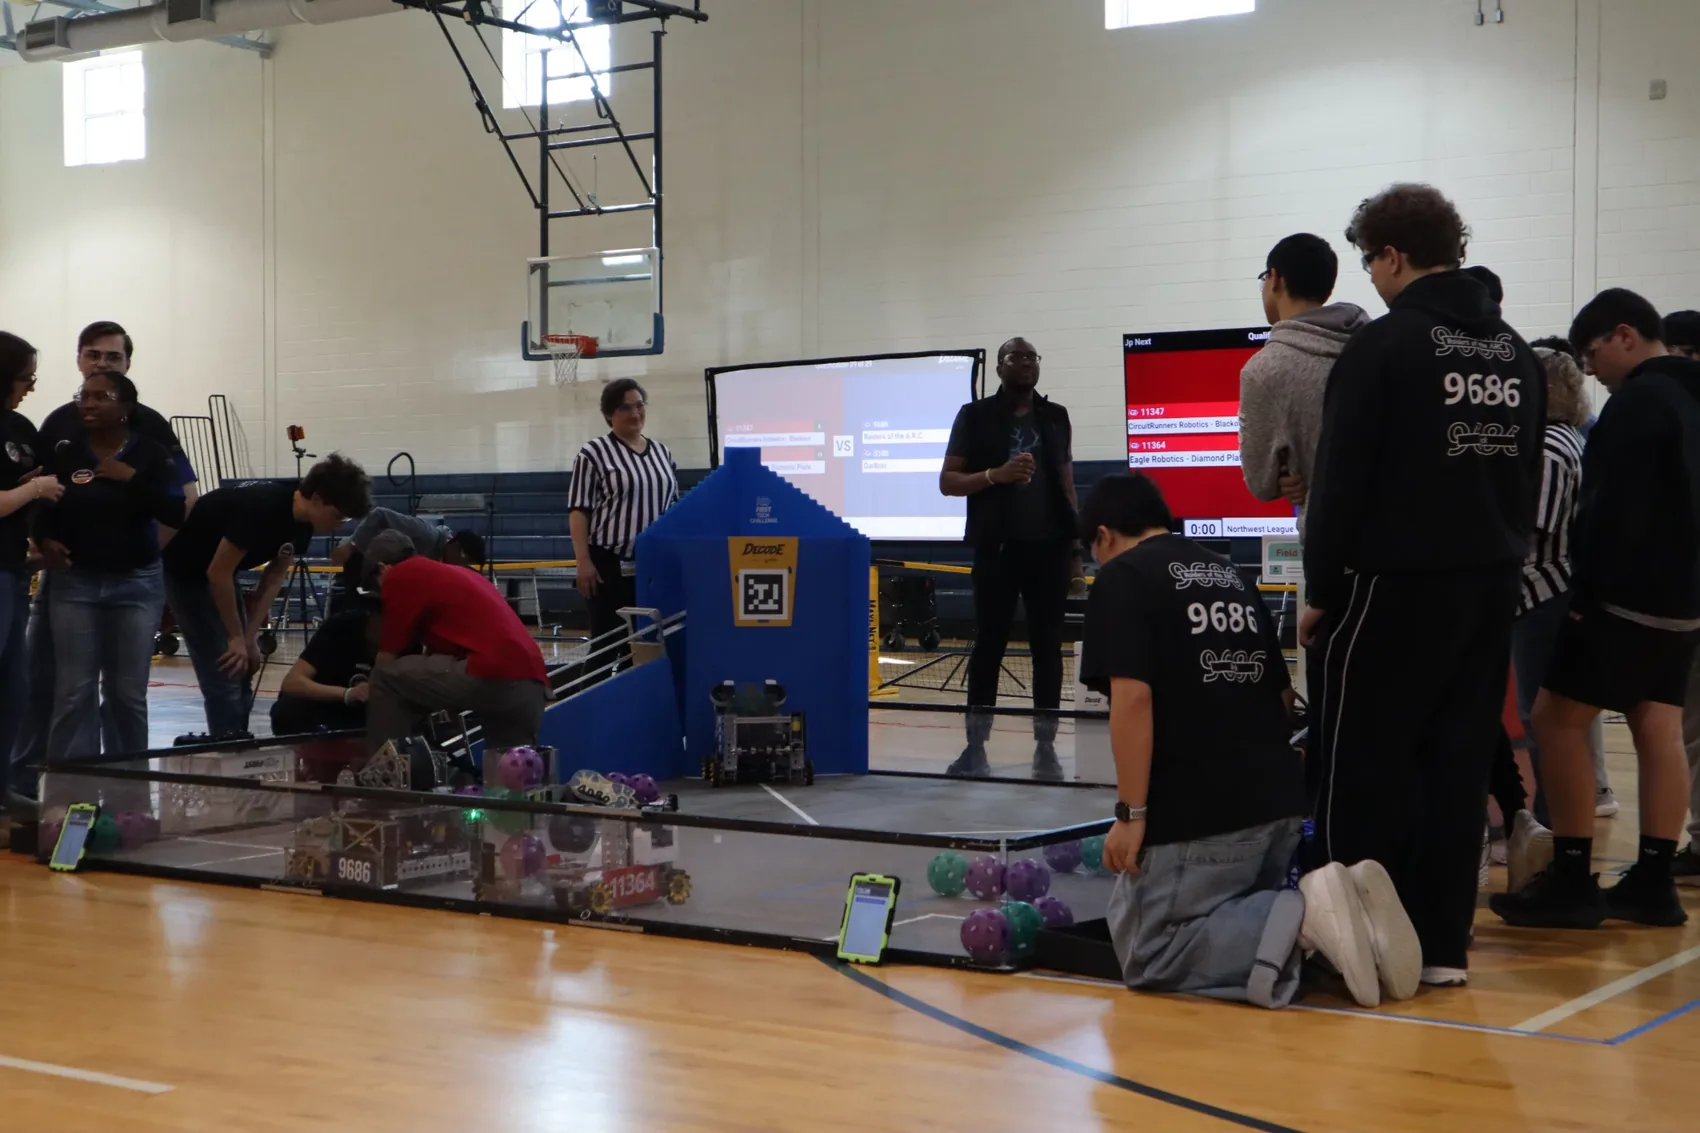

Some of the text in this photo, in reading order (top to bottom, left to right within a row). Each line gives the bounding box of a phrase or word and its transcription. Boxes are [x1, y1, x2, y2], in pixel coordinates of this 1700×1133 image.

[1135, 337, 1151, 346] Next
[1444, 372, 1521, 408] 9686
[1141, 407, 1164, 416] 11347
[1128, 421, 1178, 430] CircuitRunners
[1179, 420, 1209, 429] Robotics
[836, 440, 852, 452] VS
[1142, 441, 1166, 450] 11364
[1129, 455, 1150, 465] Eagle
[1152, 455, 1185, 463] Robotics
[1191, 454, 1225, 462] Diamond
[1190, 523, 1294, 535] 0:00 Northwest League
[1276, 548, 1298, 557] Field
[1187, 601, 1259, 635] 9686
[338, 857, 371, 884] 9686
[609, 871, 656, 899] 11364
